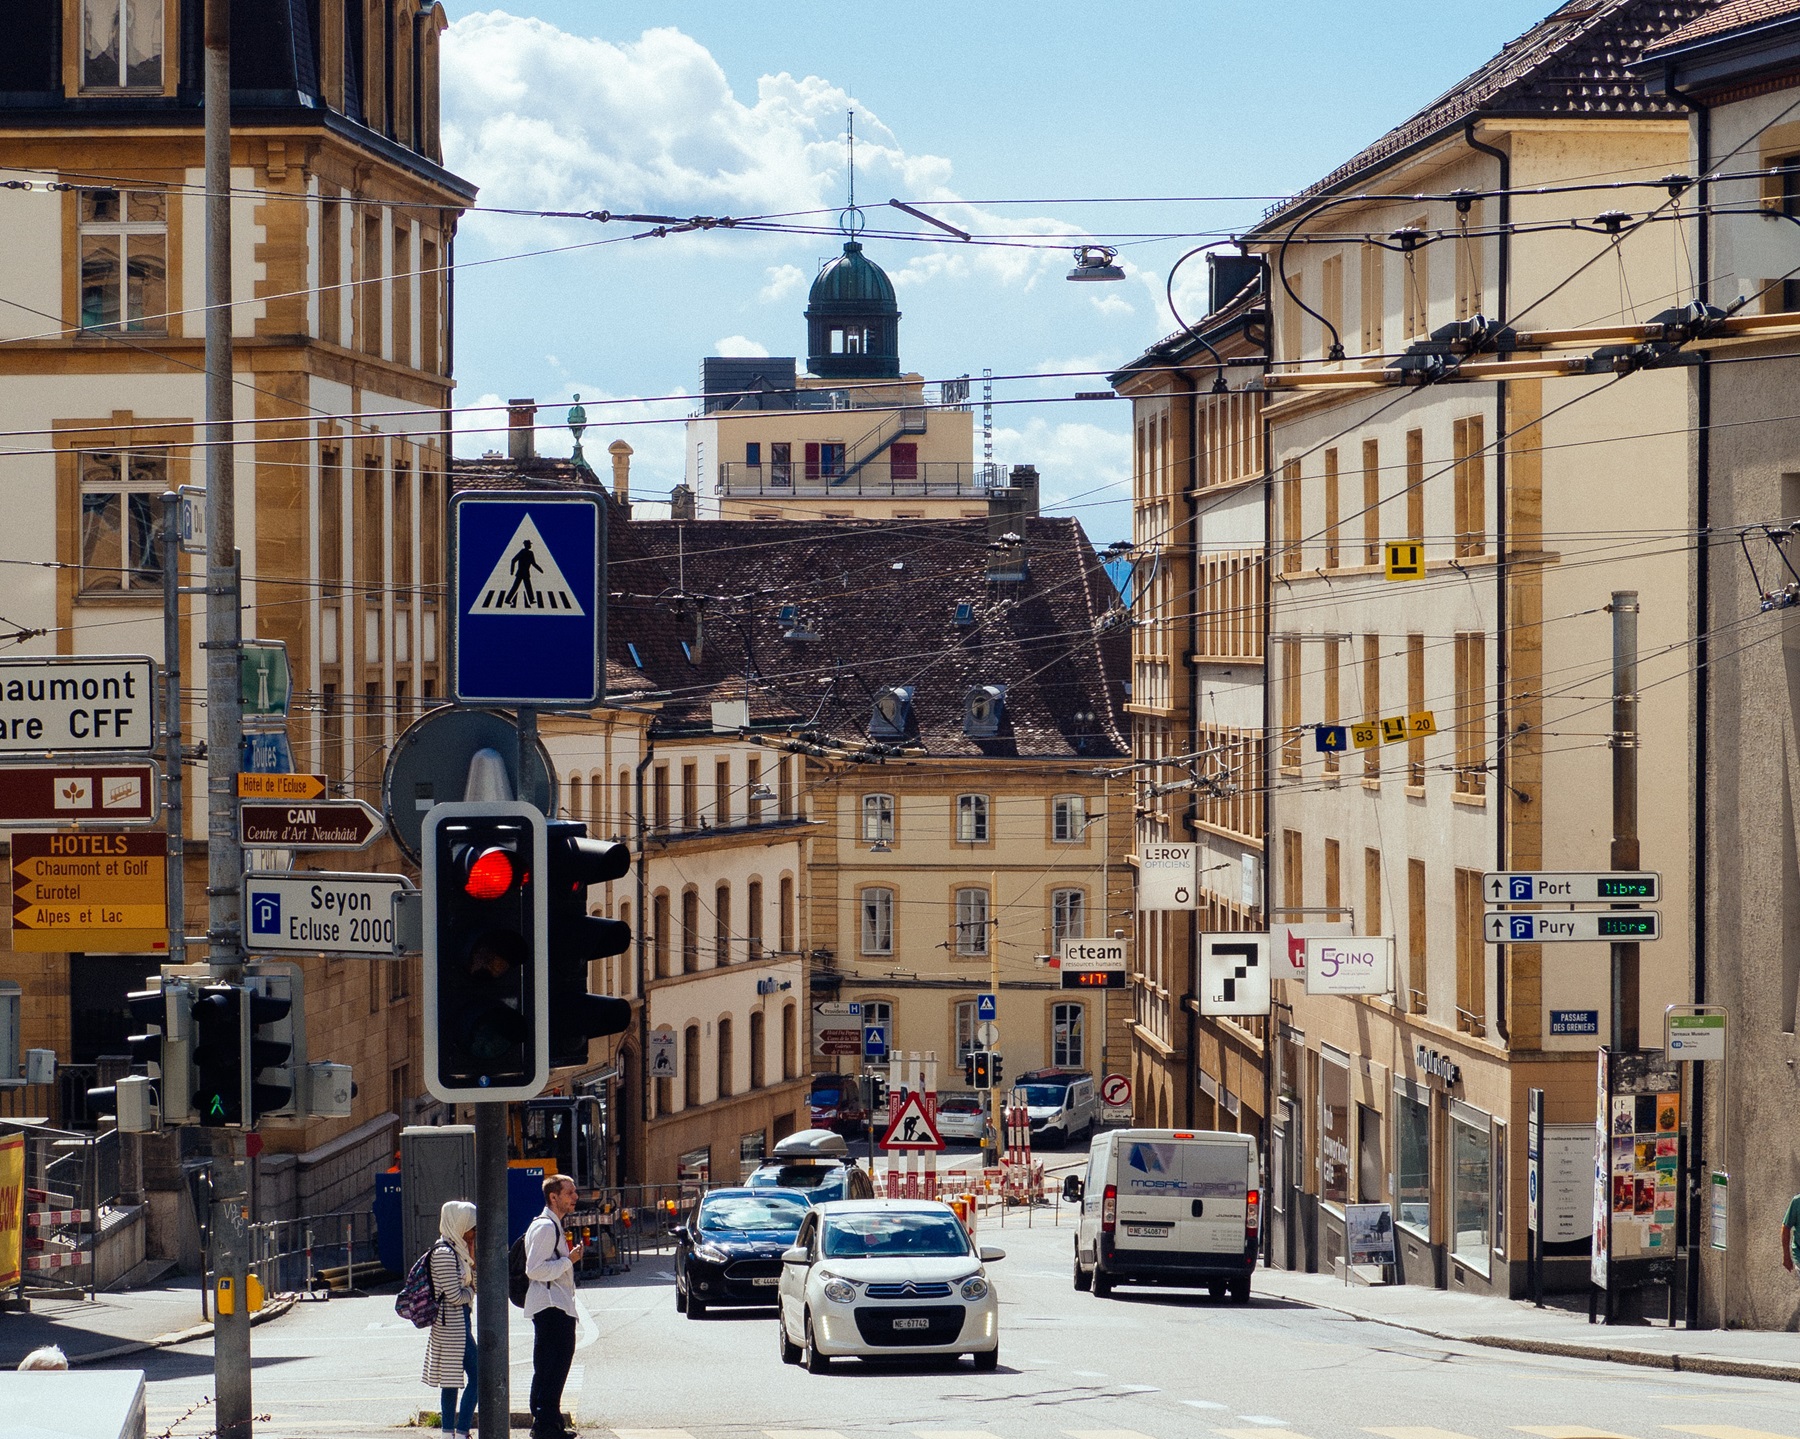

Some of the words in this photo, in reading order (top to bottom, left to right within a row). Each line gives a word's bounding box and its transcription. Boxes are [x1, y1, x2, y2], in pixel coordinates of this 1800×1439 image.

[0, 671, 136, 701] aumont
[70, 709, 133, 738] CFF
[1415, 719, 1431, 731] 20
[1325, 731, 1337, 747] 4
[1356, 729, 1374, 743] 83
[252, 739, 277, 768] Toutes
[243, 777, 263, 792] Hôtel
[265, 778, 275, 792] de
[278, 778, 307, 793] l'Ecluse
[287, 809, 316, 824] CAN
[247, 825, 278, 840] Centre
[281, 826, 307, 840] d'Art
[311, 827, 358, 841] Neuchâtel
[50, 835, 128, 854] HOTELS
[1145, 848, 1190, 860] LEROY
[35, 860, 101, 876] Chaumont
[106, 861, 119, 876] et
[123, 860, 149, 876] Golf
[1144, 860, 1191, 869] OPTICIENS
[36, 884, 81, 900] Eurotel
[1538, 881, 1572, 895] Port
[1605, 882, 1647, 895] libre
[310, 884, 371, 916] Seyon
[36, 908, 71, 926] Alpes
[79, 910, 92, 923] et
[101, 908, 123, 923] Lac
[289, 916, 340, 941] Ecluse
[349, 918, 392, 944] 2000
[1539, 920, 1575, 937] Pury
[1606, 921, 1647, 933] libre
[1320, 947, 1340, 978] 5
[1335, 952, 1375, 967] CINQ
[1560, 1013, 1588, 1022] PASSAGE
[1553, 1022, 1566, 1032] DES
[1567, 1022, 1596, 1032] GRENIERS
